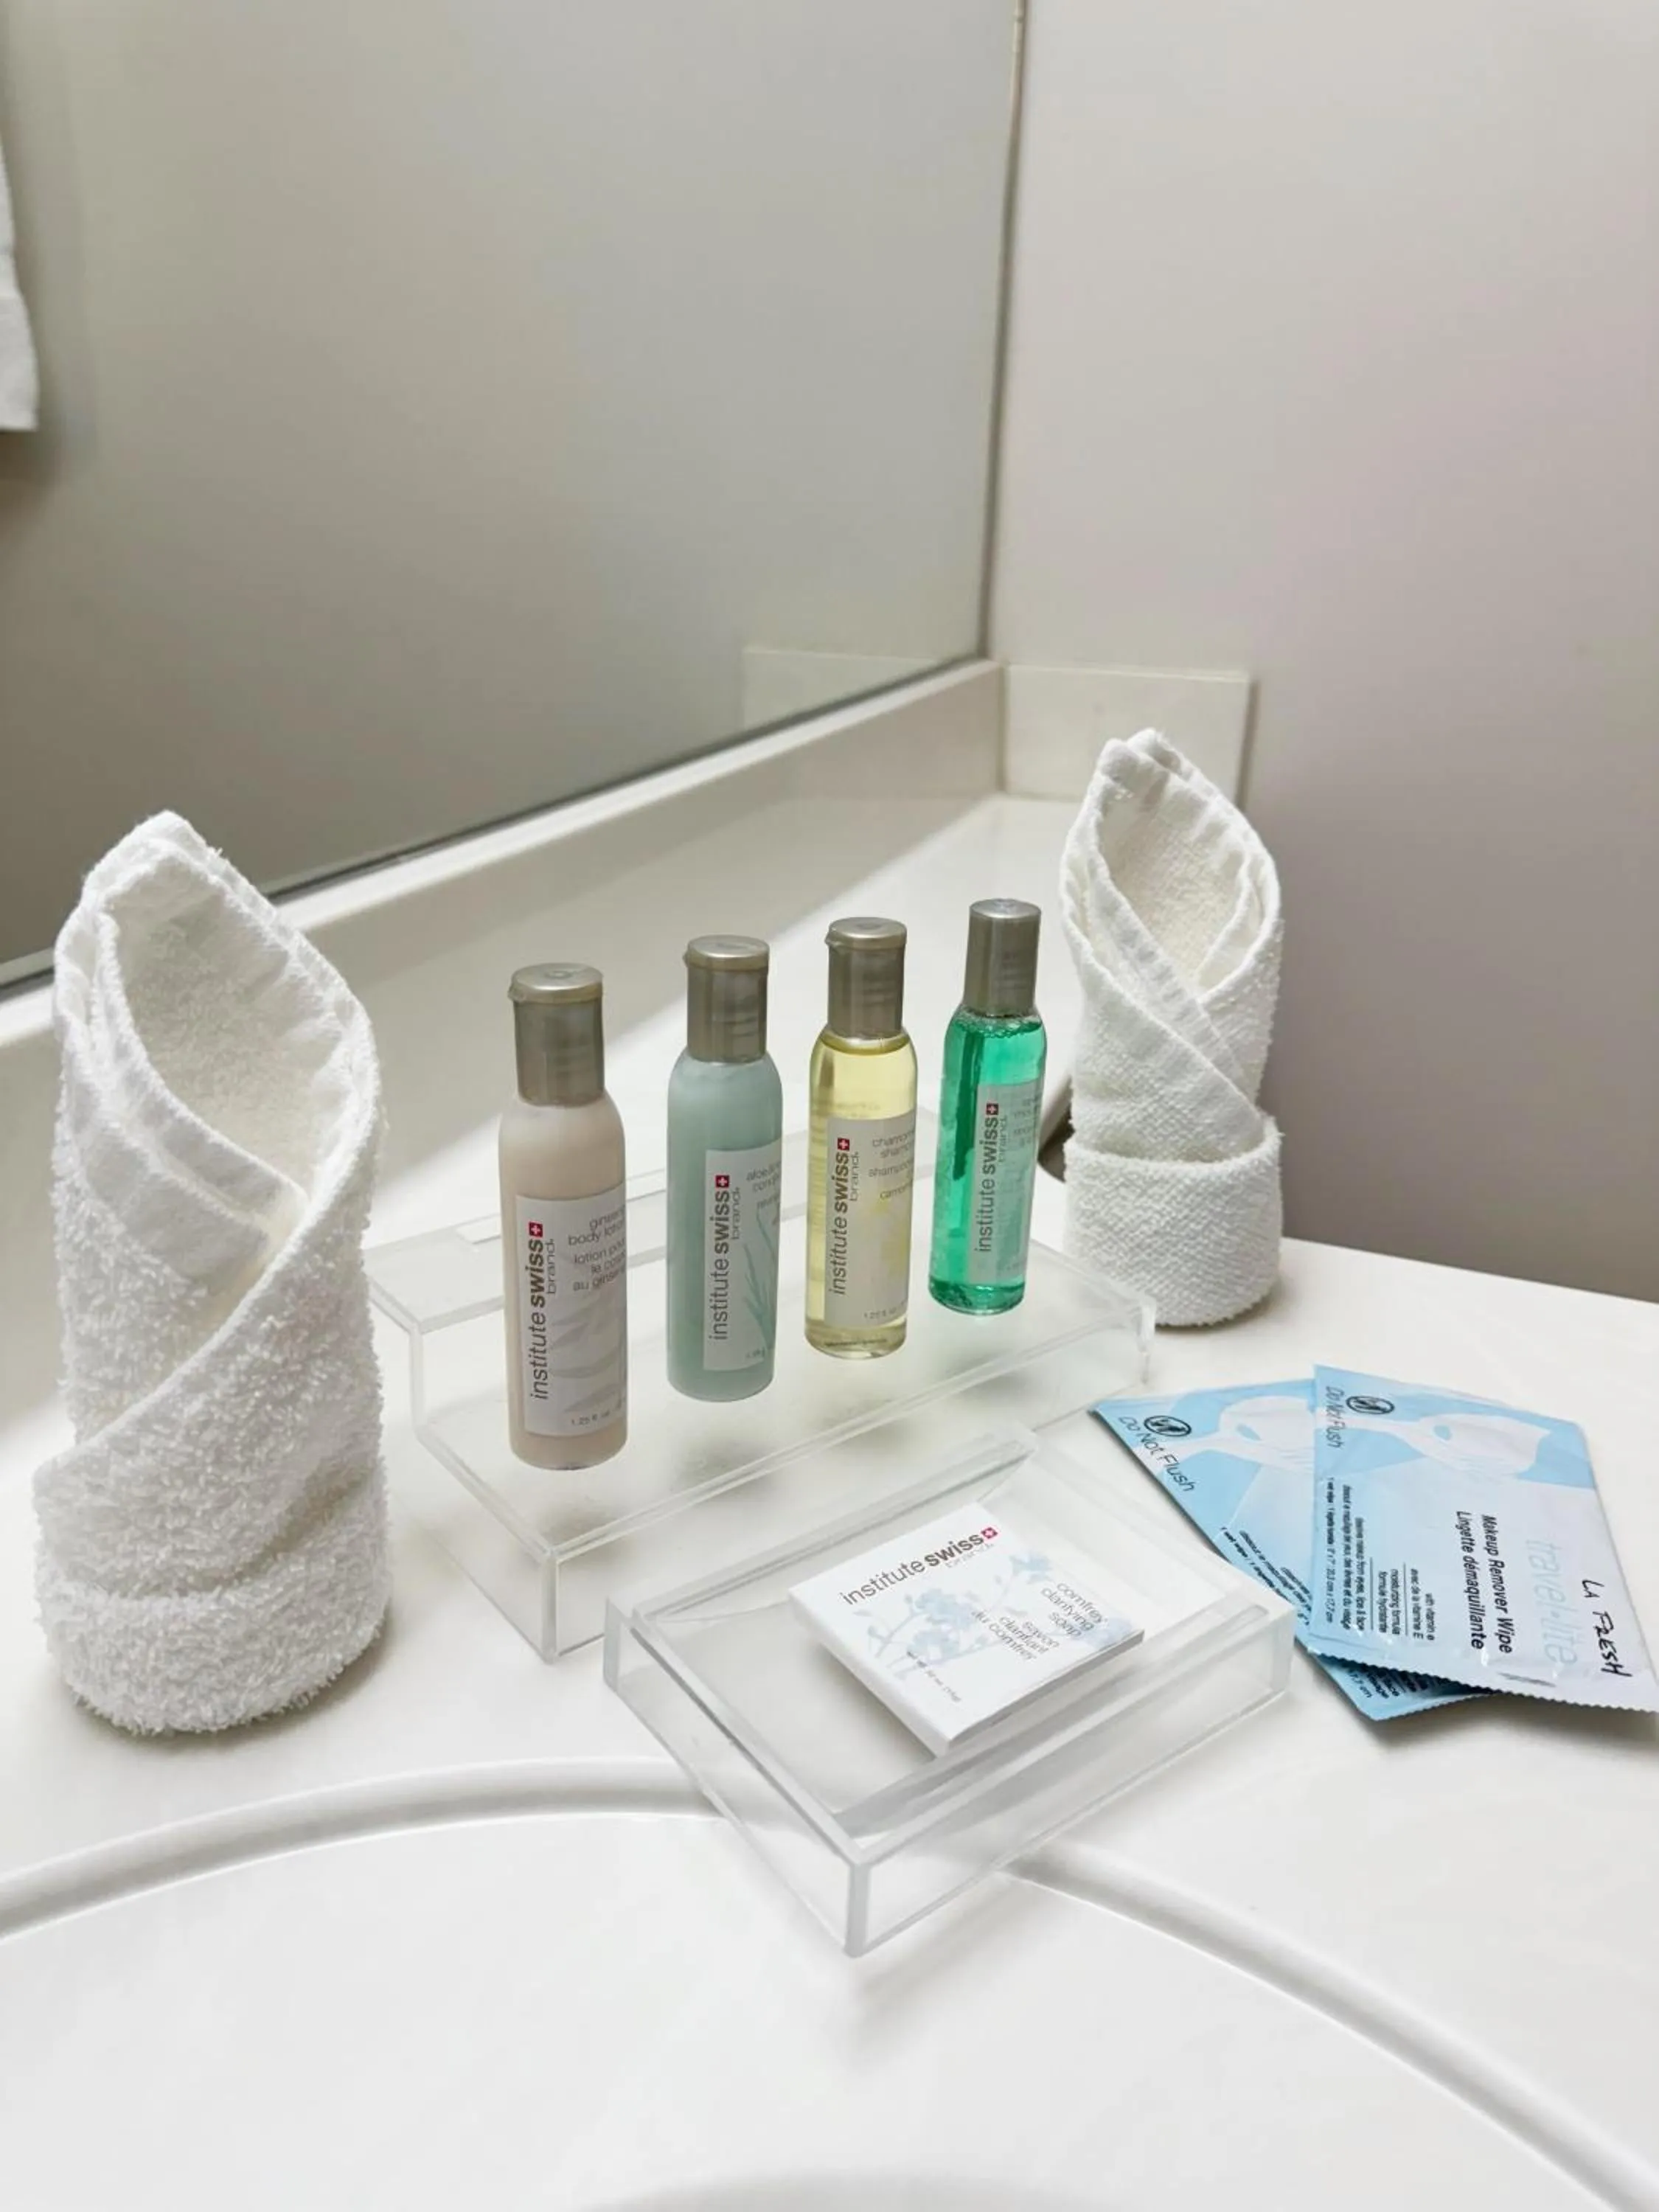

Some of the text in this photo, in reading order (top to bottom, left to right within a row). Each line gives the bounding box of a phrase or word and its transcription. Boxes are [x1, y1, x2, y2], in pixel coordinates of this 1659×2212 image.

[974, 1117, 998, 1251] institute swiss
[568, 1232, 602, 1246] body
[574, 1248, 606, 1263] lotion
[830, 1152, 849, 1295] institute swiss
[546, 1239, 557, 1294] brand
[709, 1190, 730, 1340] institute swiss
[525, 1239, 548, 1400] institute swiss
[1326, 1385, 1346, 1448] Do Not Flush
[1118, 1416, 1196, 1492] Do Not Flush
[840, 1534, 984, 1605] institute swiss
[1057, 1582, 1104, 1624] comfrey
[1455, 1511, 1487, 1649] Lingette démaquillante
[1481, 1514, 1515, 1654] Makeup Remover Wipe
[1040, 1587, 1095, 1632] clarifying
[1049, 1612, 1082, 1638] soap
[1582, 1579, 1633, 1677] LA FRESH
